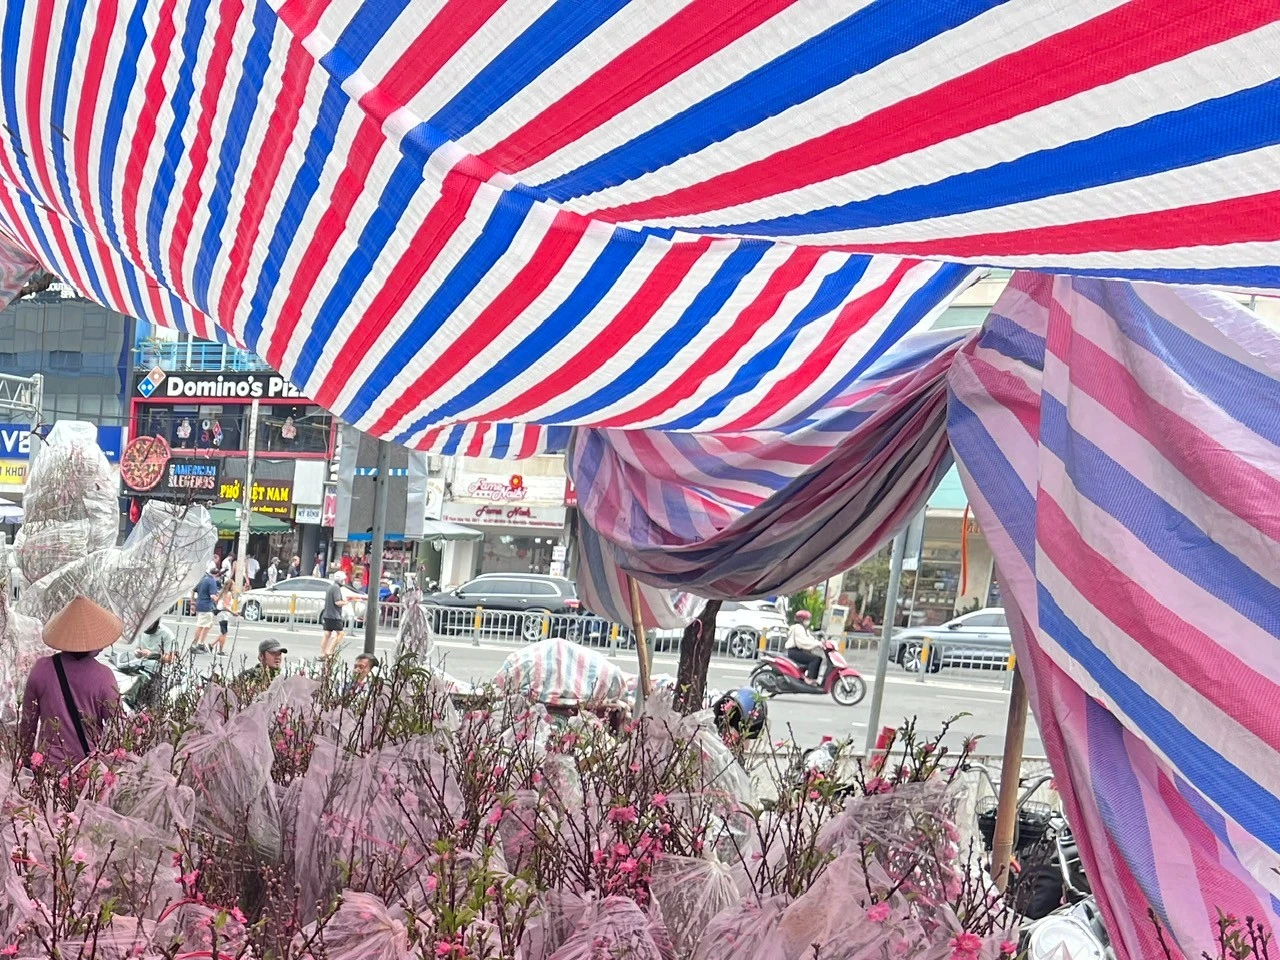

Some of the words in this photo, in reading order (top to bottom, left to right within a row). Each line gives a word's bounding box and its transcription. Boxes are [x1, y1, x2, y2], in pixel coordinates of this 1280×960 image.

[166, 376, 263, 397] Domino's
[268, 376, 307, 398] Piz
[219, 479, 240, 499] PHỞ
[266, 487, 289, 502] NAM
